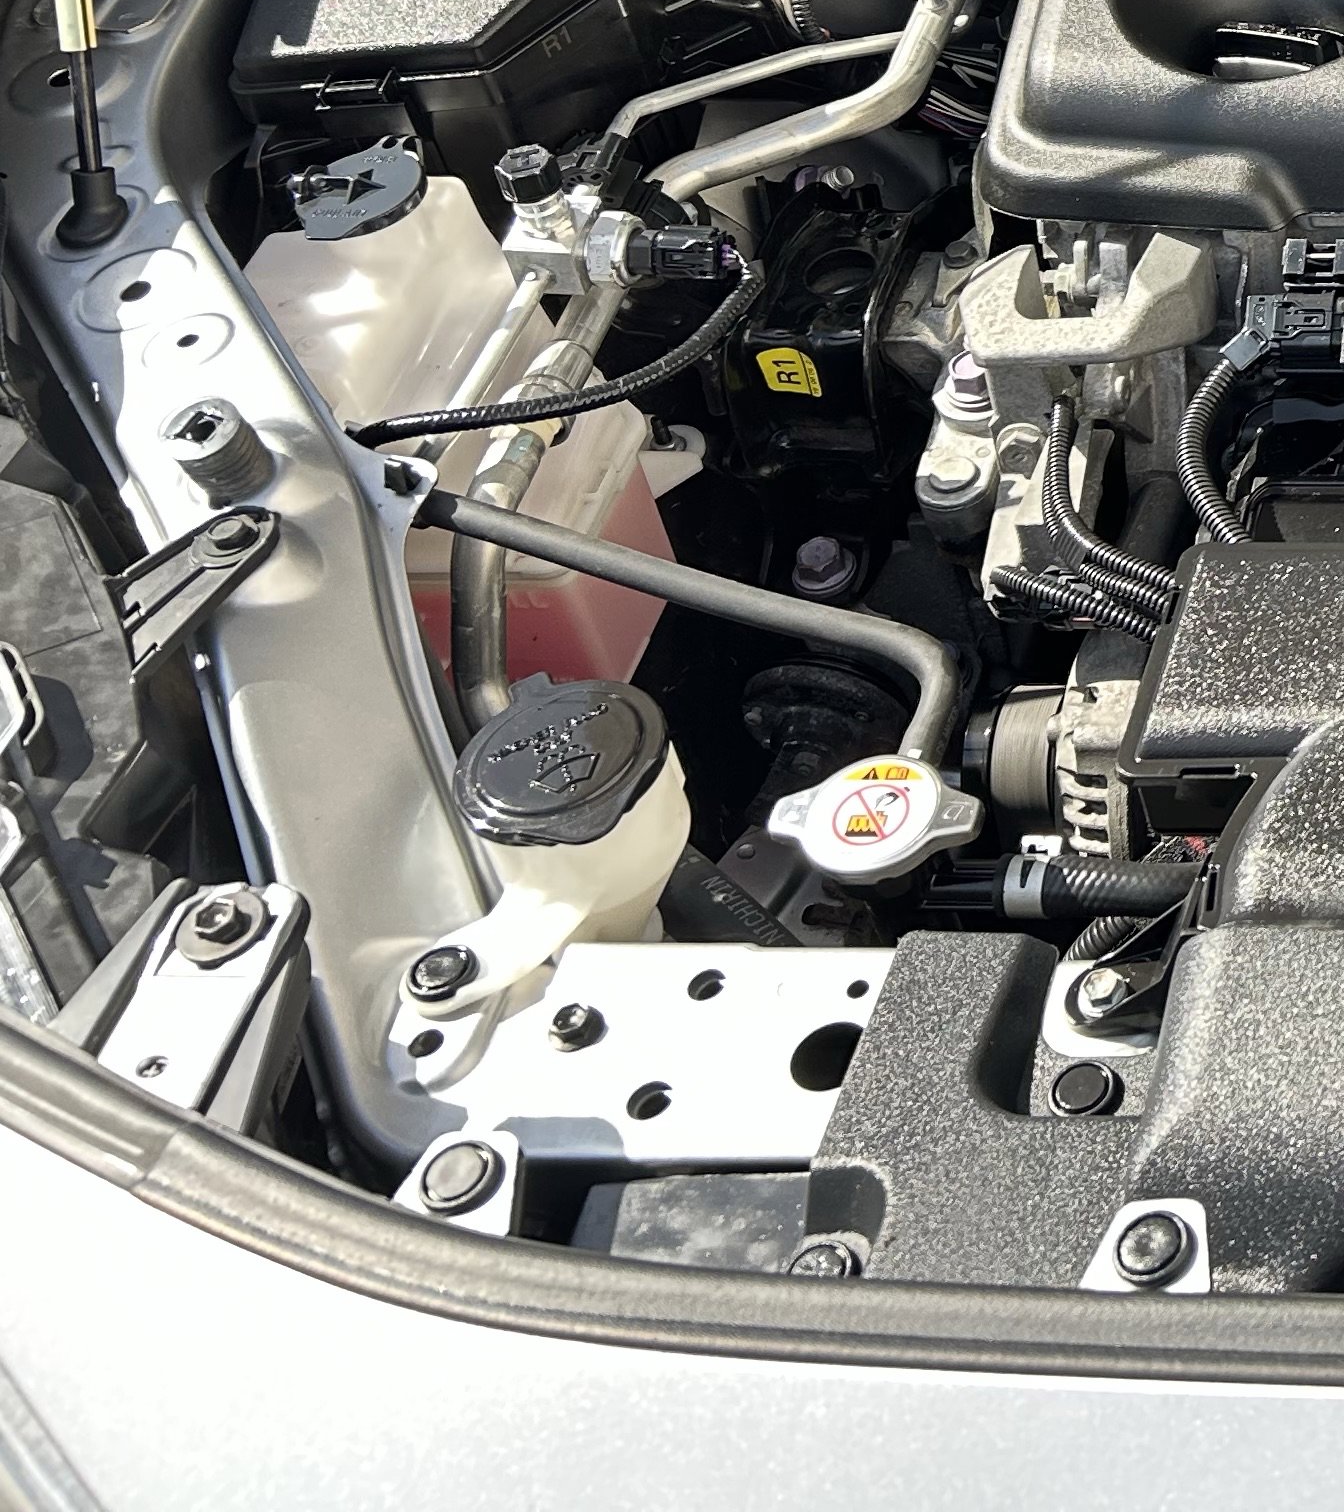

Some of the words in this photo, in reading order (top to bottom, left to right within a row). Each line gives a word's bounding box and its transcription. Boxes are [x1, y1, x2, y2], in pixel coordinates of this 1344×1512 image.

[541, 25, 572, 58] R1
[771, 359, 802, 385] R1
[700, 875, 784, 944] NICHIRIN
